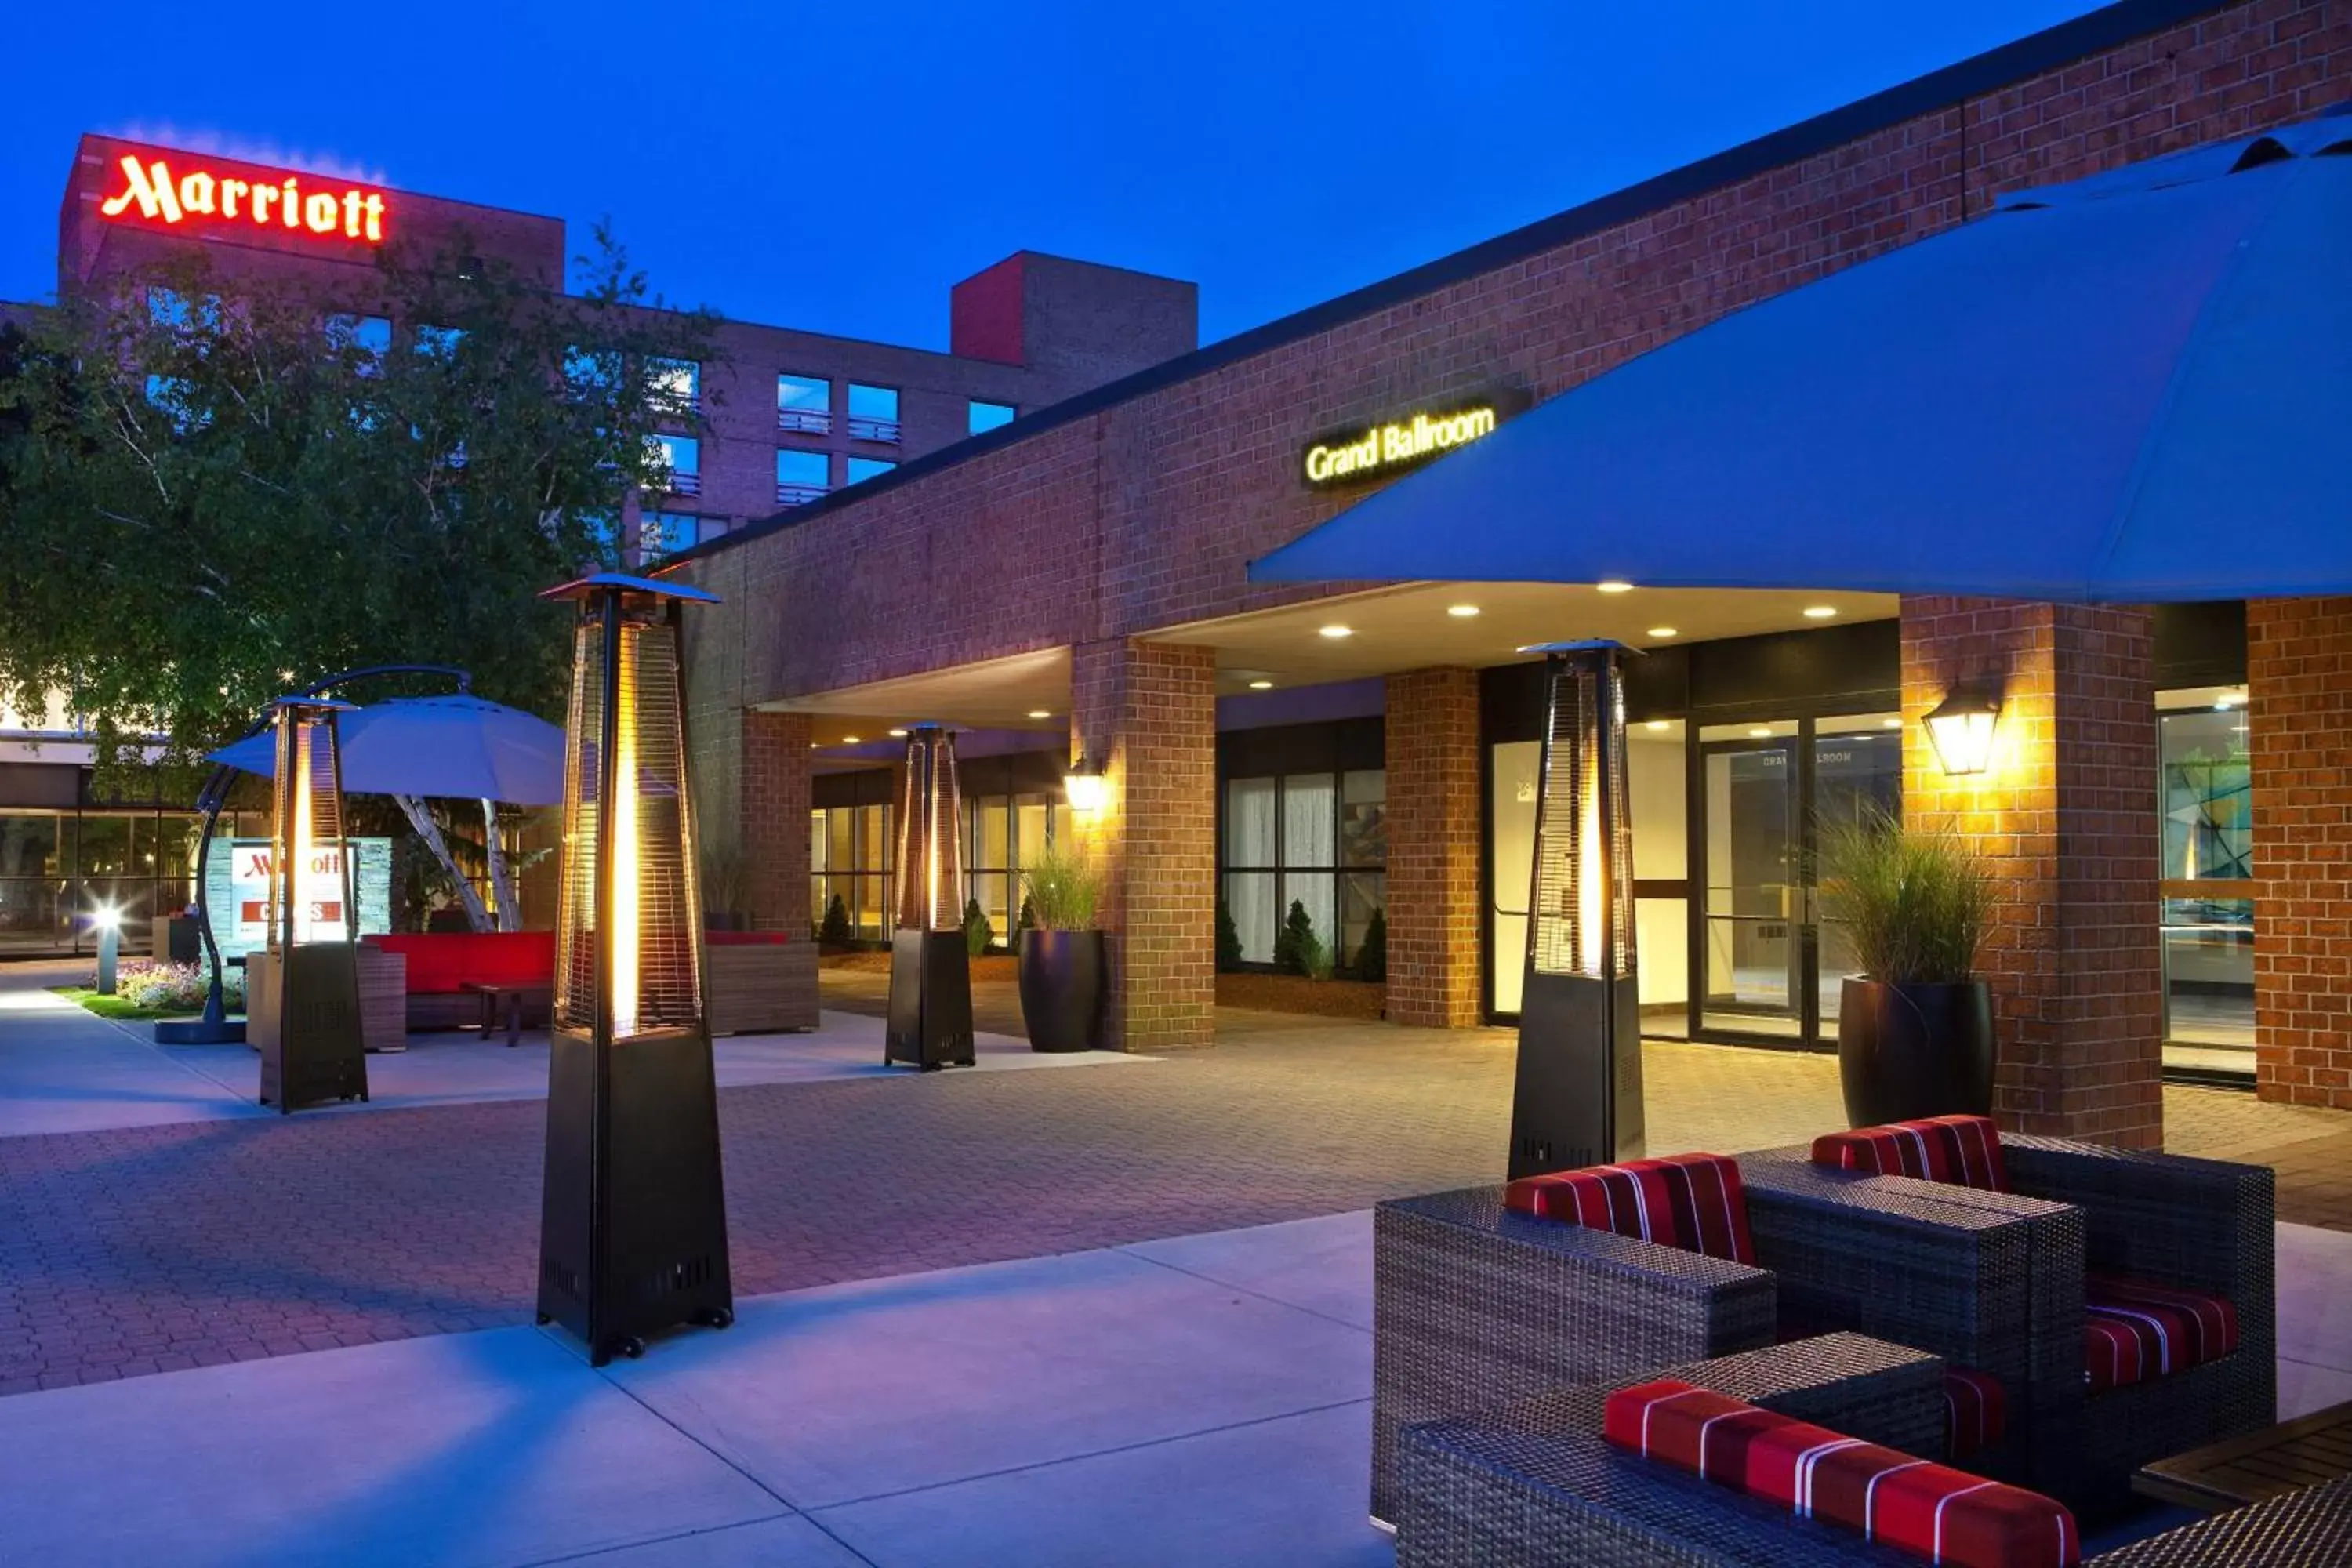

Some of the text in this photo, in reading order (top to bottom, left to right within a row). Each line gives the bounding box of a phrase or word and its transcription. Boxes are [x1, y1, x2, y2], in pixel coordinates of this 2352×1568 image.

[101, 155, 385, 241] Marriott
[1306, 408, 1494, 481] Grand Ballroom
[1816, 752, 1851, 764] LROOM
